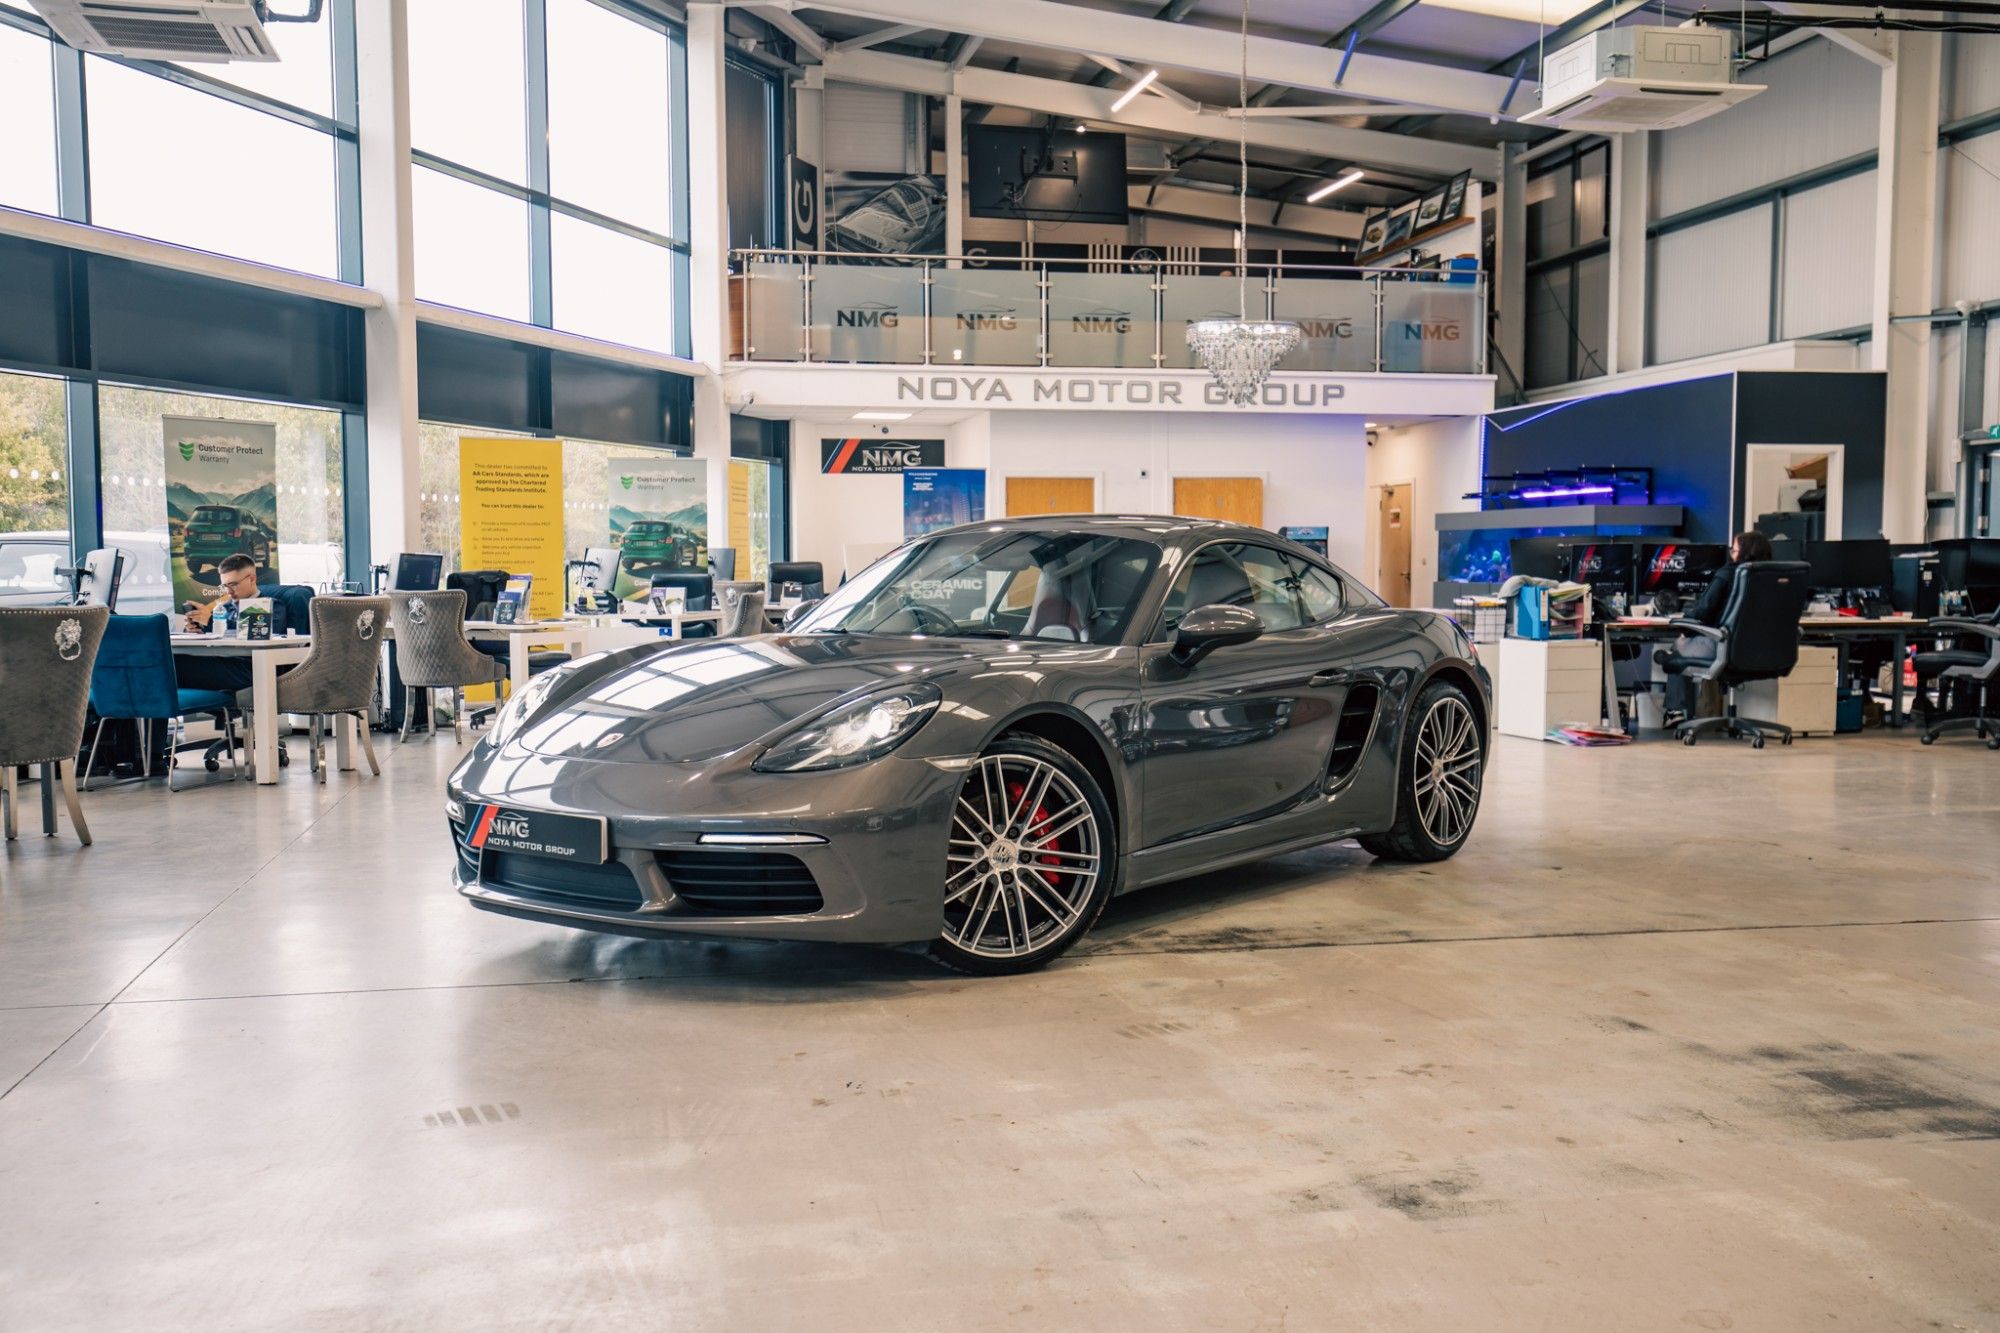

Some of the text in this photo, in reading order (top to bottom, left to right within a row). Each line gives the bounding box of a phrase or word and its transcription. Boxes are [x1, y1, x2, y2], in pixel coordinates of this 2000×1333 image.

[836, 310, 899, 328] NMG
[956, 312, 1018, 331] NMG
[1072, 316, 1132, 334] NMG
[1297, 321, 1353, 338] NMG
[1404, 324, 1460, 341] NMG
[898, 376, 1012, 402] NOYA
[1033, 378, 1183, 404] MOTOR
[198, 444, 264, 455] Customer Protect
[862, 449, 922, 467] NMG
[199, 455, 230, 464] Warranty
[1651, 559, 1685, 569] NMG
[910, 579, 983, 590] CERAMIC
[910, 590, 954, 600] COAT
[488, 816, 530, 838] NMG
[488, 837, 575, 856] NOYA MOTOR GROUP
